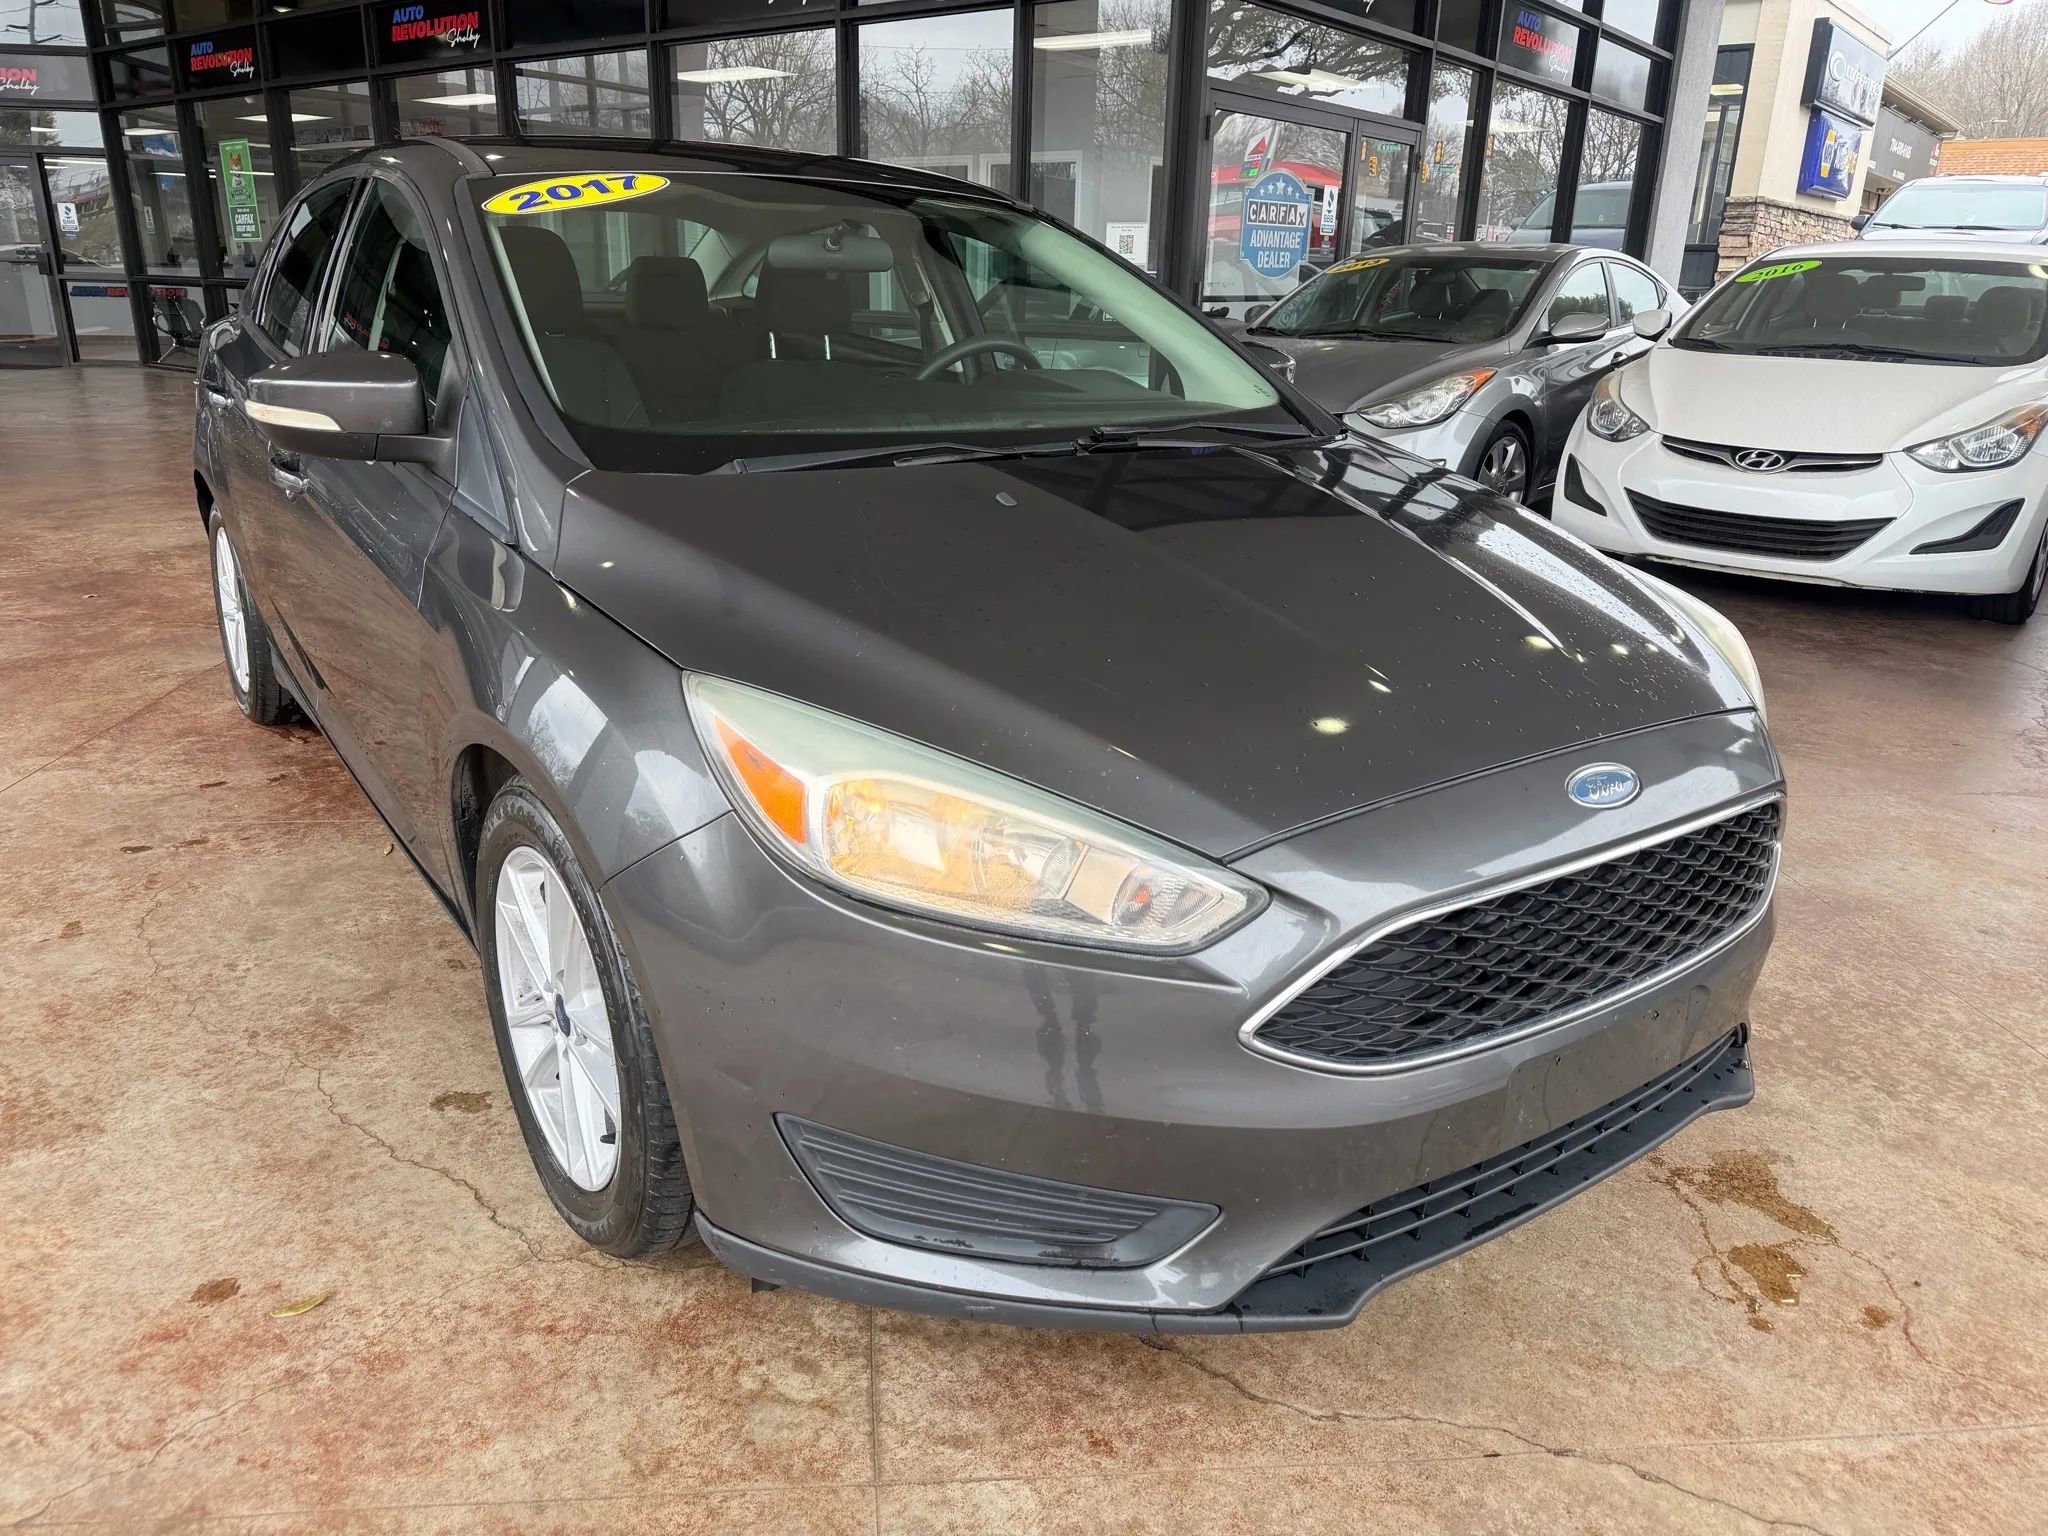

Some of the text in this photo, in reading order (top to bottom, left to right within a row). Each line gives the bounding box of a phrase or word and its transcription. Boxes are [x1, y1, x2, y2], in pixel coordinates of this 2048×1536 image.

[393, 5, 424, 23] AUTO
[1517, 11, 1542, 31] AUTO
[392, 12, 479, 42] REVOLUTION
[447, 25, 480, 48] Shelby
[191, 41, 213, 56] AUTO
[1513, 26, 1573, 64] REVOLUTION
[191, 48, 252, 71] REVOLUTION
[230, 58, 254, 79] Shelby
[509, 175, 639, 212] 2017
[235, 213, 254, 225] CARFAX
[1248, 202, 1307, 227] CARFAX
[1249, 229, 1302, 249] ADVANTAGE
[1257, 250, 1291, 268] DEALER
[1753, 264, 1804, 280] 2016
[1585, 775, 1627, 800] Ford
